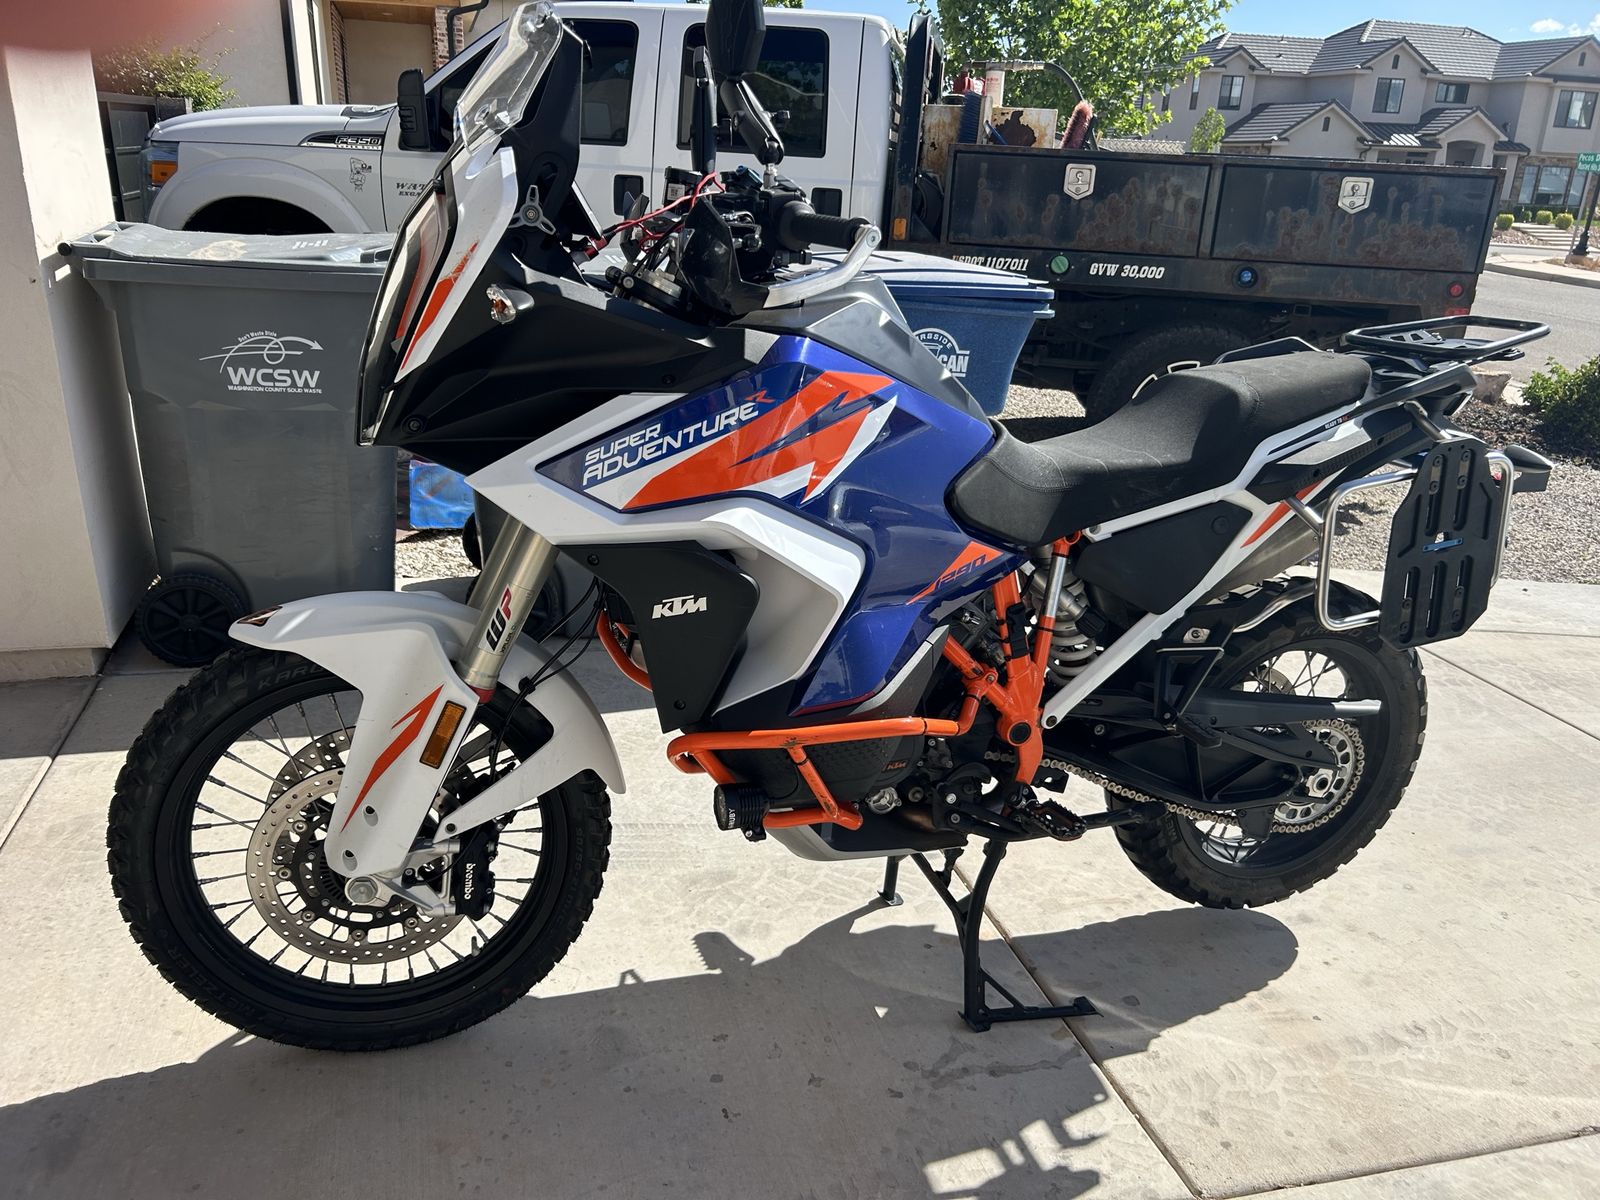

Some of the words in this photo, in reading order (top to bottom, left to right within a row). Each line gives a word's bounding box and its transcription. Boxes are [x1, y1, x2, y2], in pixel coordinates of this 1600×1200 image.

[335, 135, 381, 145] F350
[986, 256, 1029, 271] 1107011
[1089, 262, 1118, 277] GVW
[1121, 264, 1165, 279] 30,000
[916, 332, 953, 349] RBSIDE
[226, 366, 320, 388] WCSW
[1324, 420, 1337, 429] READY
[582, 402, 759, 486] ADVENTURE
[584, 423, 661, 466] SUPER
[652, 595, 707, 619] KTM
[463, 863, 476, 900] brembo
